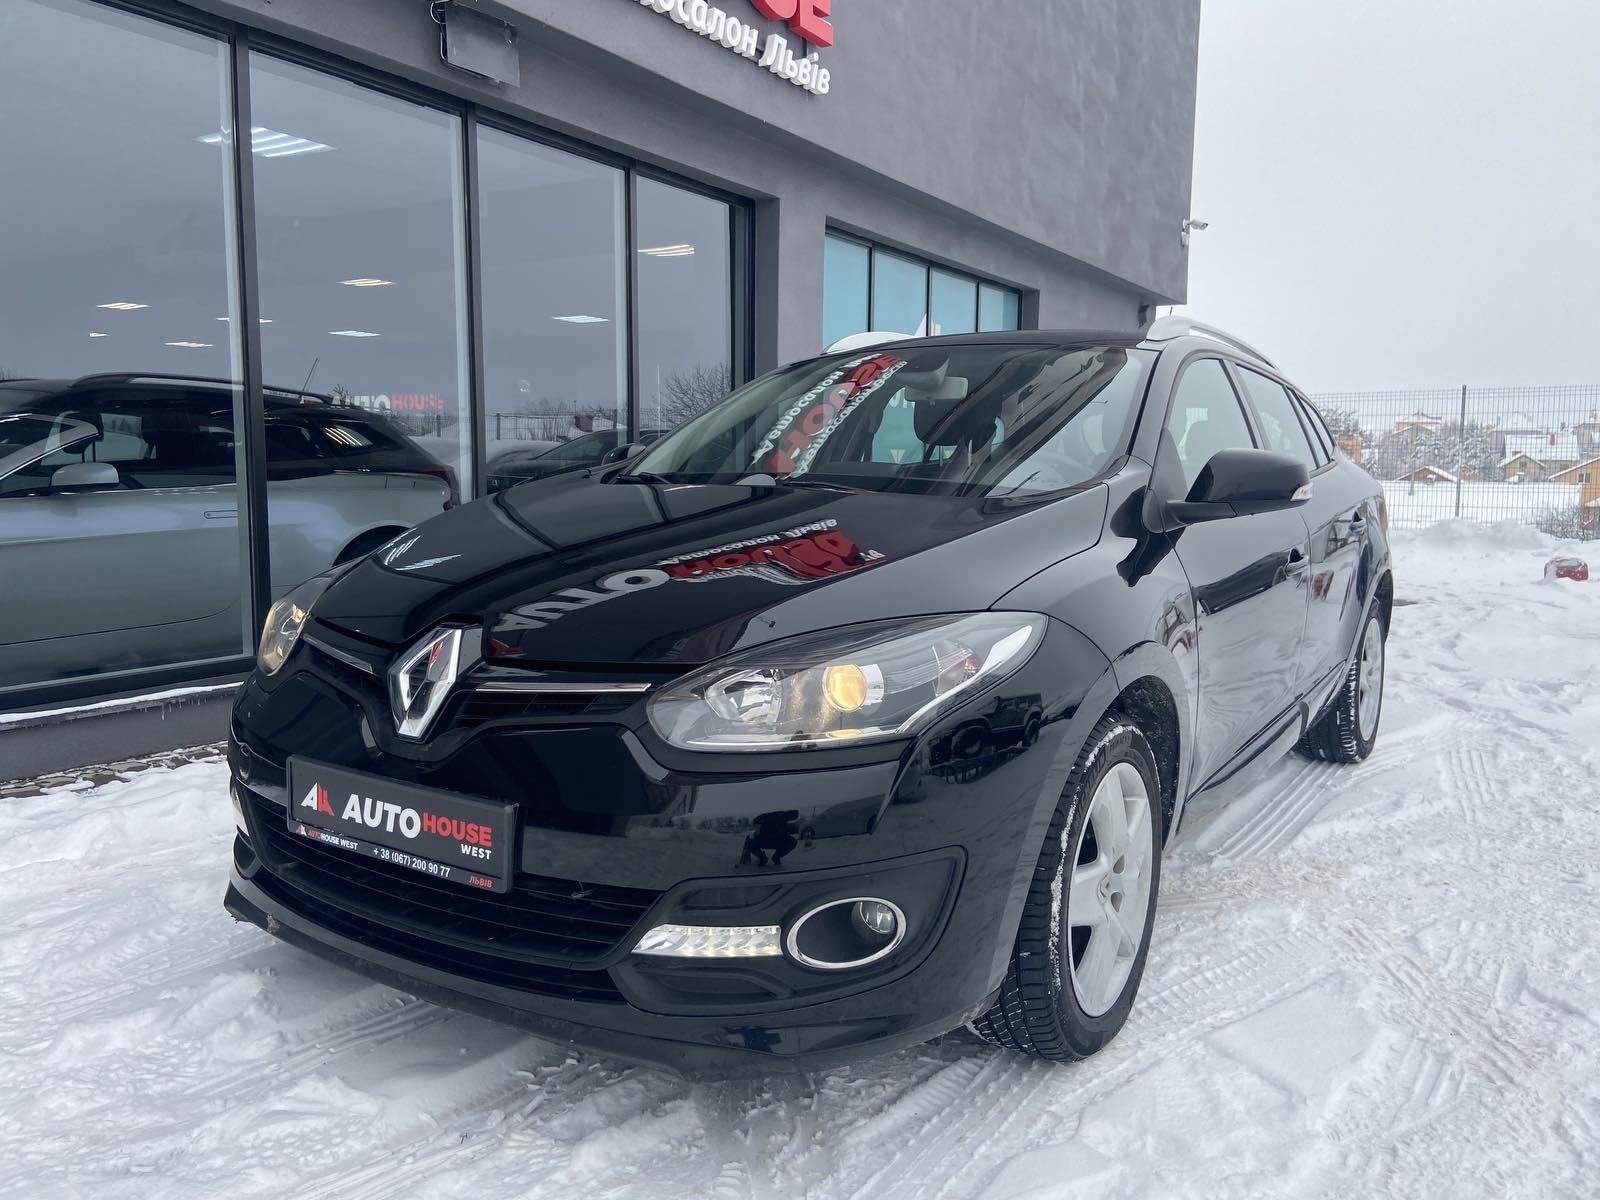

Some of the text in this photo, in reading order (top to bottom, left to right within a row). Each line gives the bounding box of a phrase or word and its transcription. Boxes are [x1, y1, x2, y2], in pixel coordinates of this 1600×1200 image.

[758, 33, 831, 95] Львів
[342, 793, 493, 847] AUTO HOUSE
[340, 838, 358, 850] WEST
[460, 843, 492, 860] WEST
[412, 858, 427, 871] 200
[428, 863, 438, 875] 90
[440, 866, 451, 878] 77
